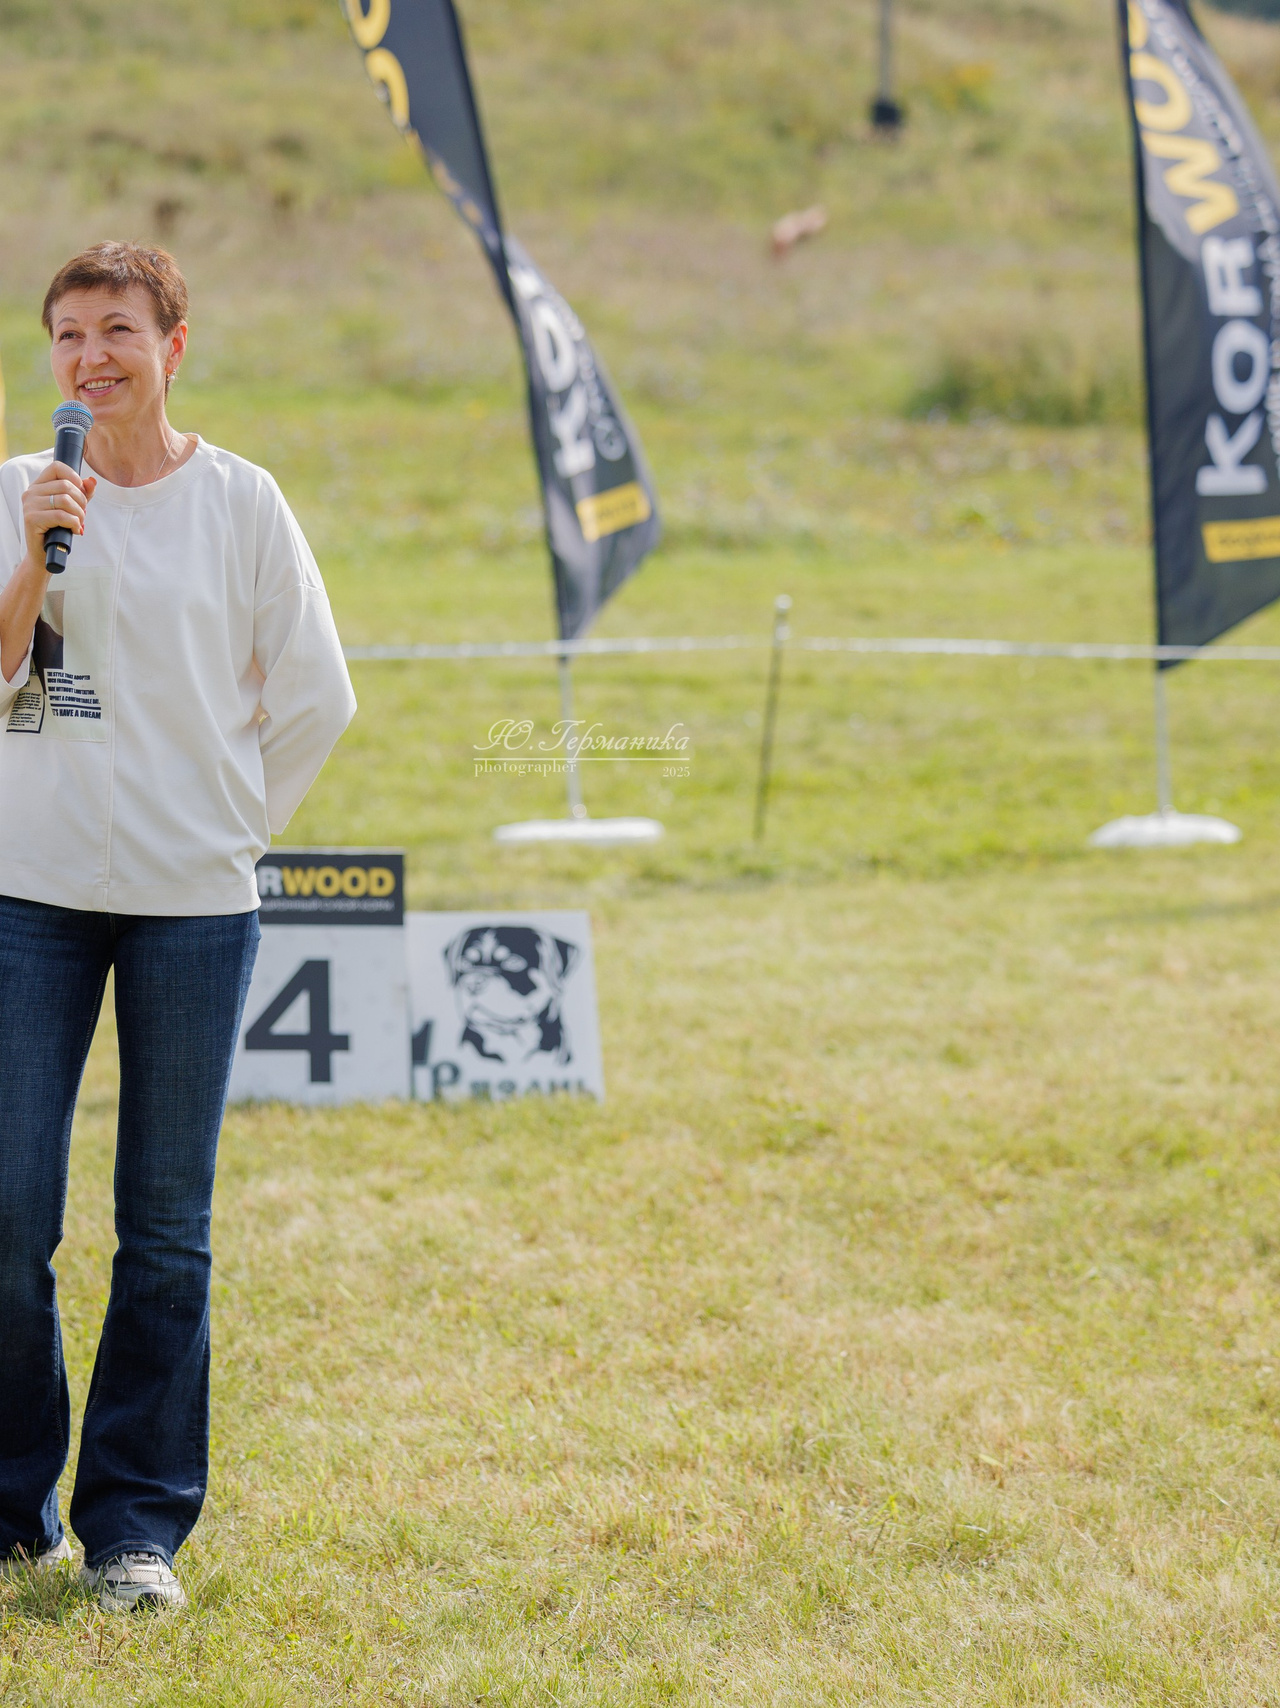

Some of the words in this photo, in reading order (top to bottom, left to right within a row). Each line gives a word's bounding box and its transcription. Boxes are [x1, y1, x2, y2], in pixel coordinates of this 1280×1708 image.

[60, 709, 73, 717] HAVE
[74, 709, 79, 717] A
[80, 710, 101, 719] DREAM
[257, 866, 396, 898] RWOOD
[245, 959, 350, 1082] 4
